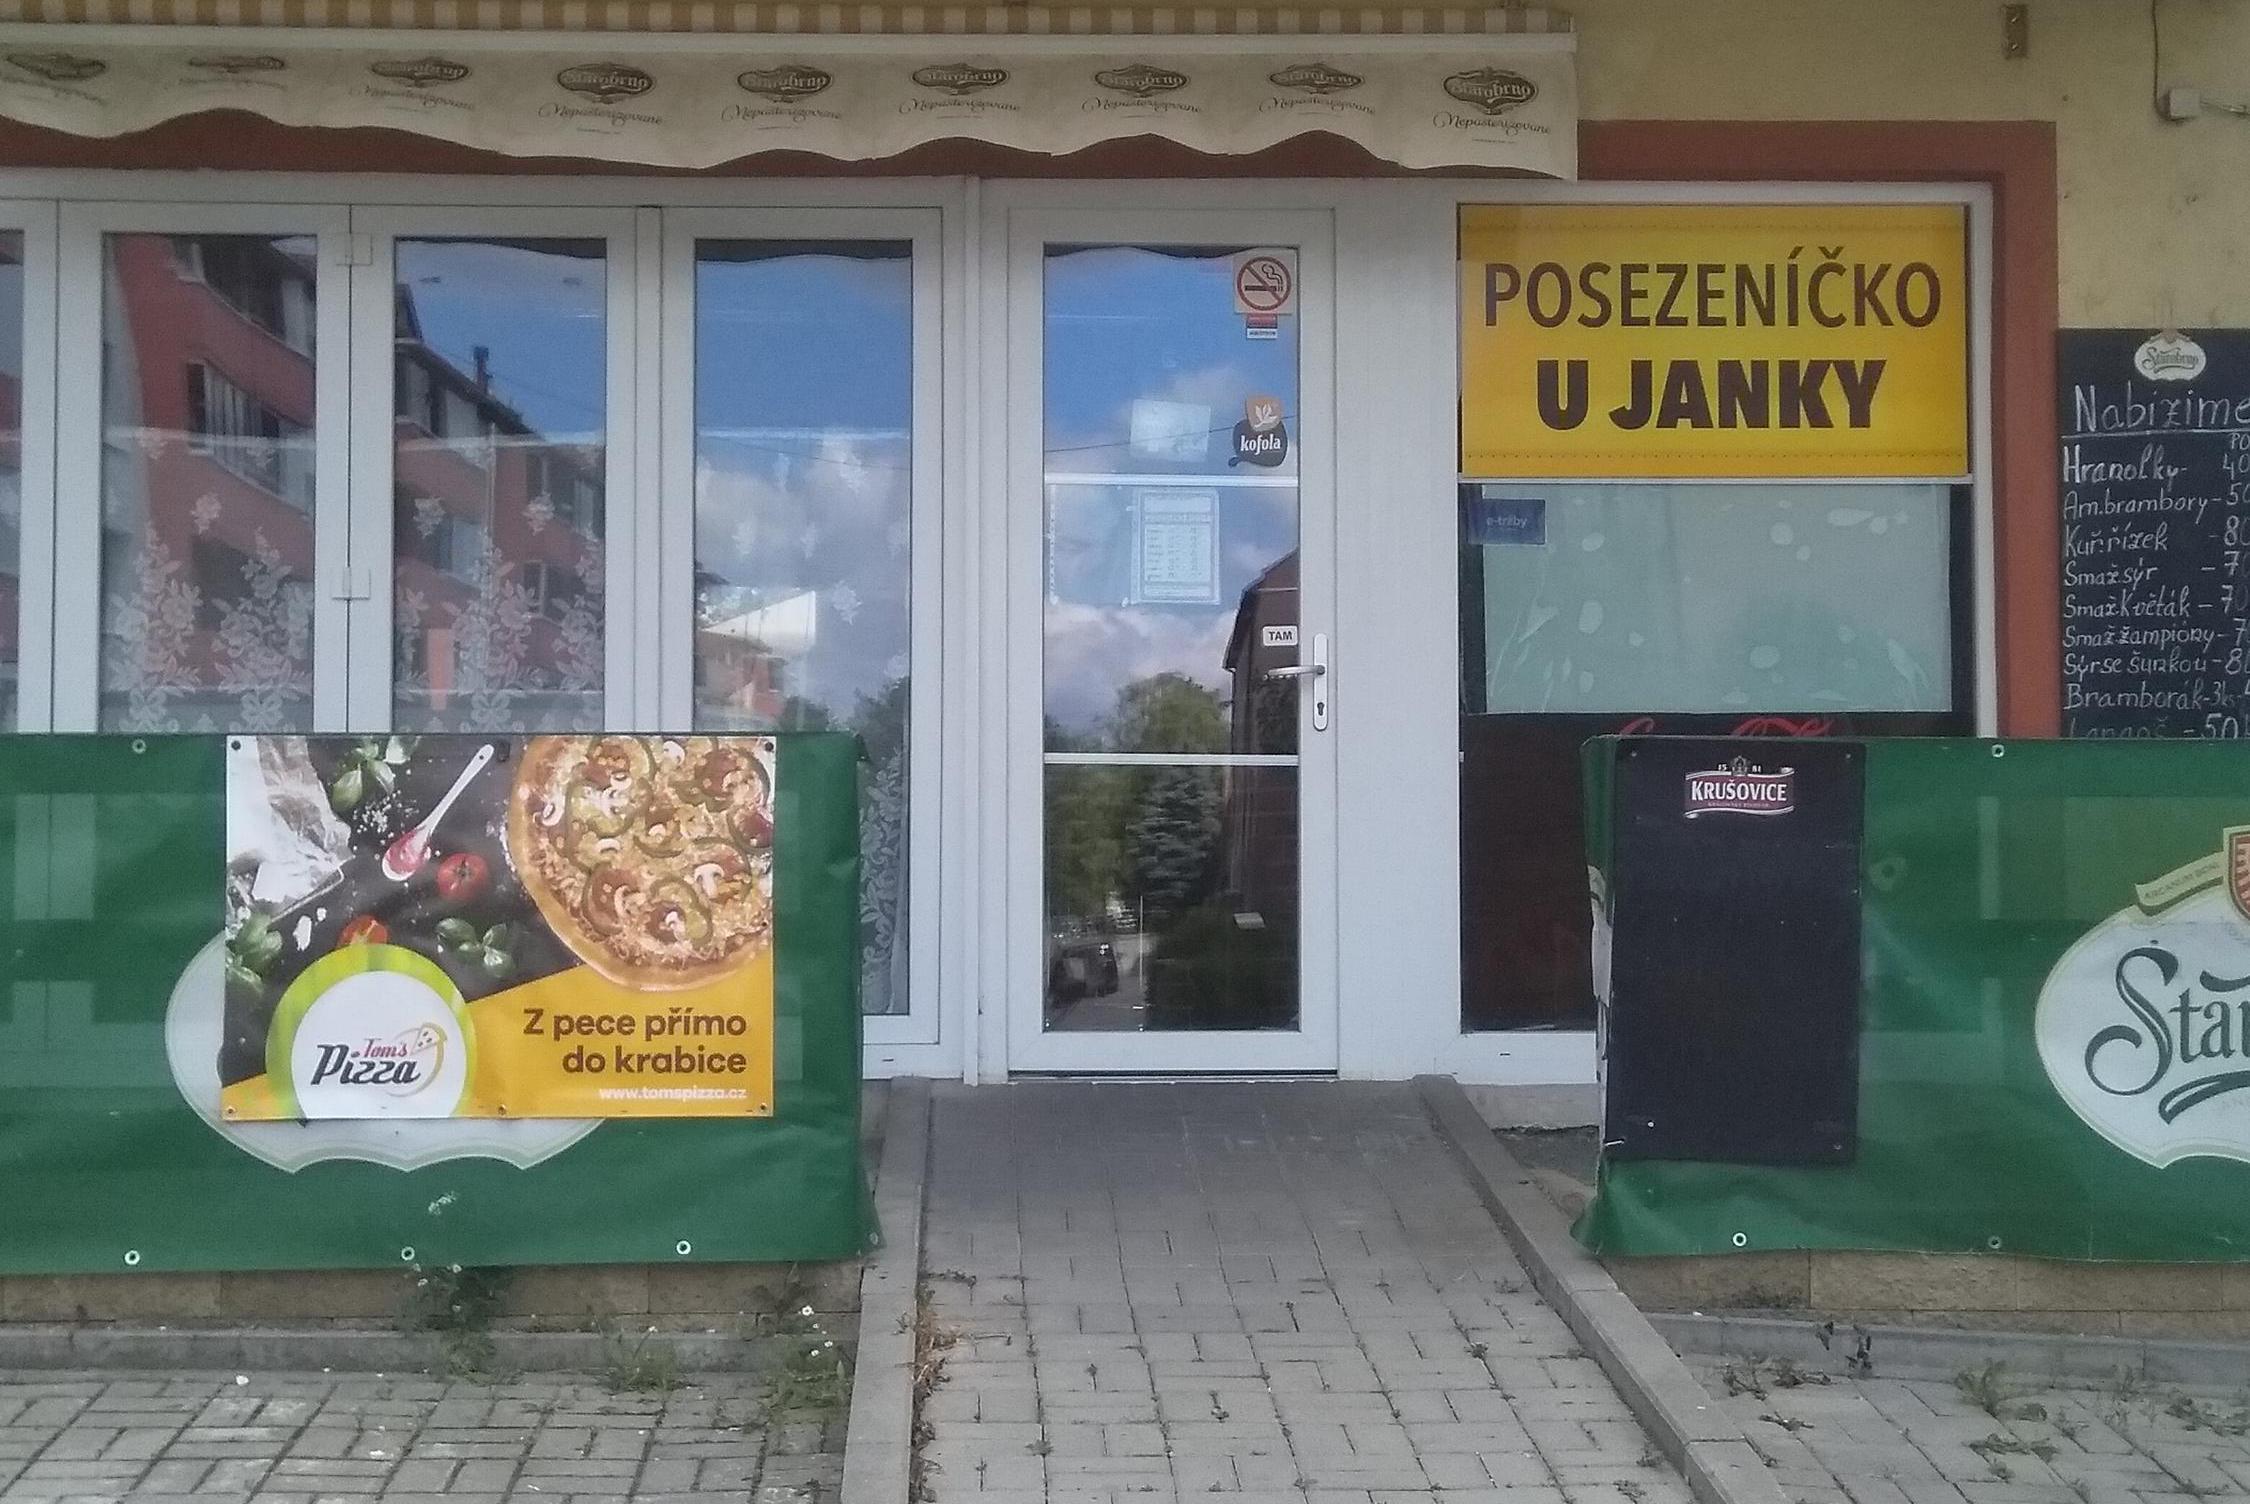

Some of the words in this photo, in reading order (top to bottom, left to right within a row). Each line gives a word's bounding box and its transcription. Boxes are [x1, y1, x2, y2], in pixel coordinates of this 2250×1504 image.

[1483, 245, 1942, 328] POSEZENÍČKO
[1536, 359, 1590, 430] U
[1608, 359, 1887, 430] JANKY
[1240, 433, 1281, 456] kofola
[1268, 631, 1293, 641] TAM
[1691, 779, 1788, 802] KRUŠOVICE
[523, 1008, 545, 1035] Z
[553, 1014, 636, 1041] pece
[645, 1007, 747, 1041] přímo
[363, 1038, 408, 1058] Tom's
[562, 1045, 606, 1074] do
[615, 1045, 748, 1074] krabice
[310, 1044, 421, 1085] Pizza
[599, 1085, 748, 1102] www.tomspizza.cz
